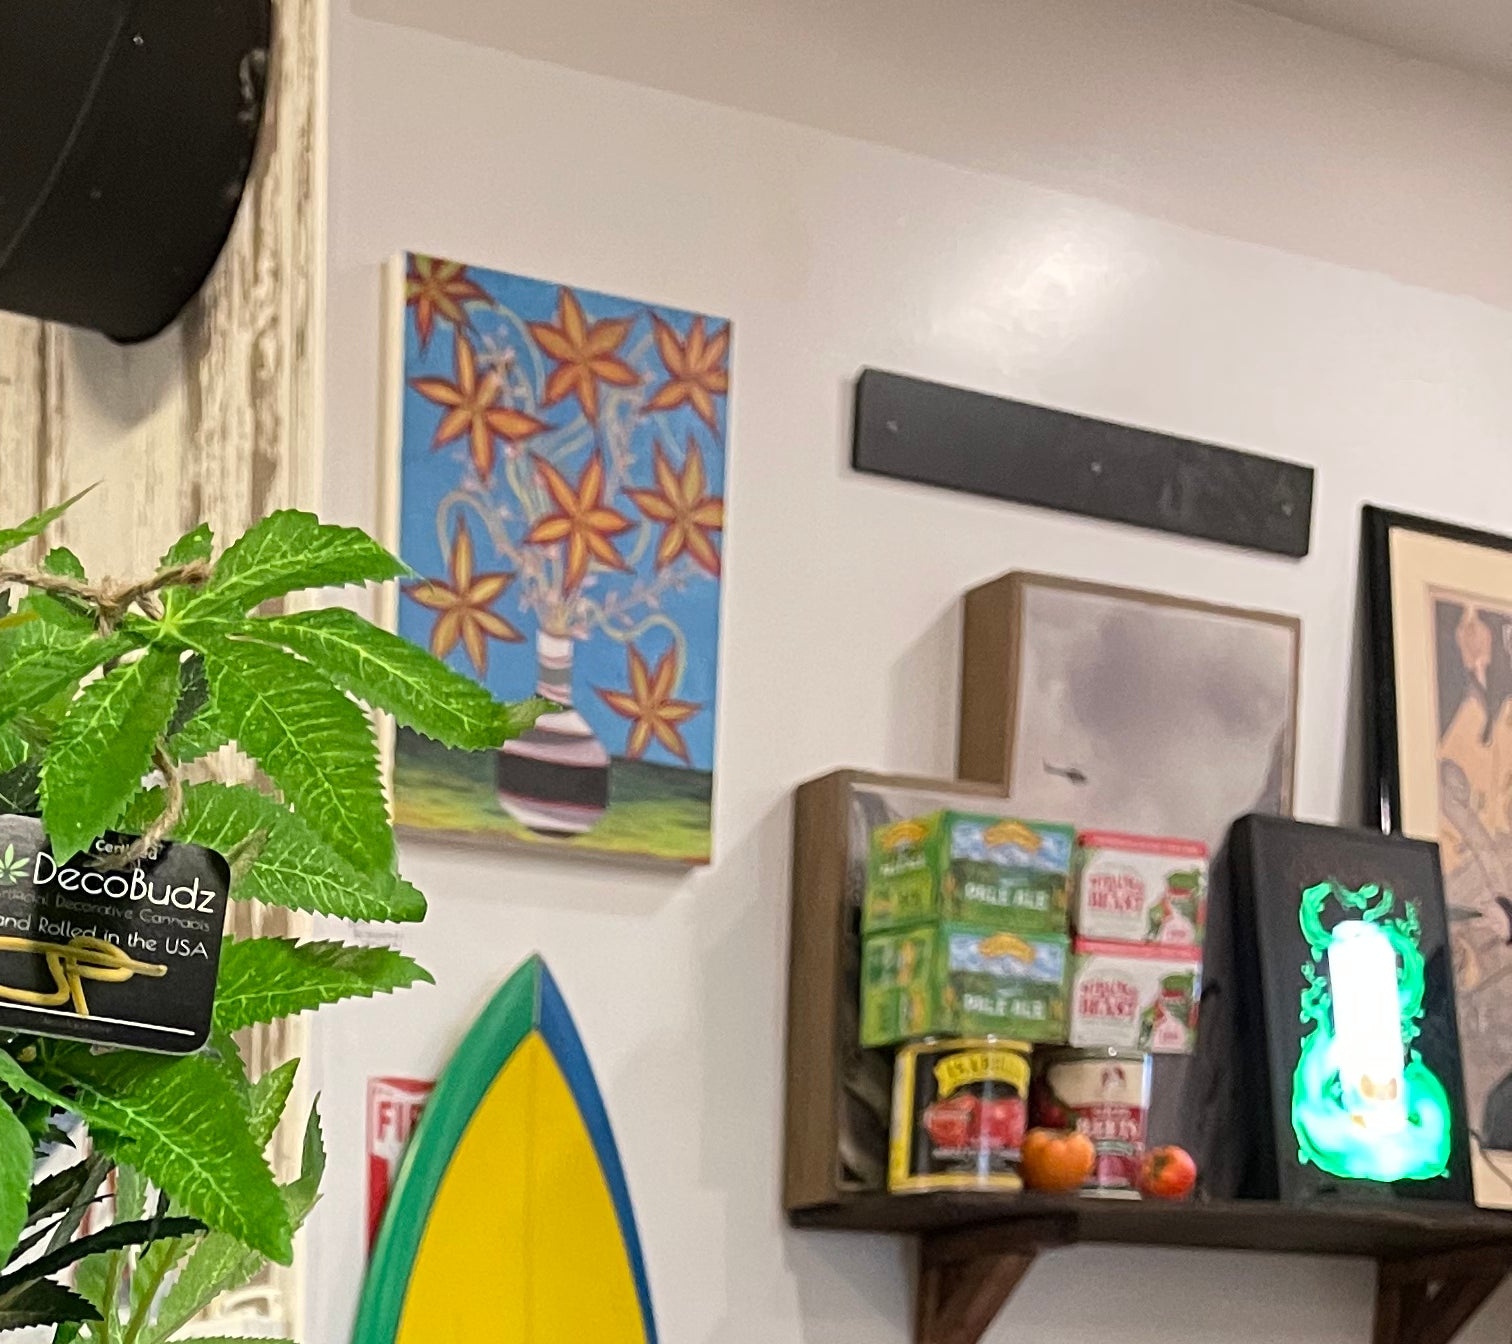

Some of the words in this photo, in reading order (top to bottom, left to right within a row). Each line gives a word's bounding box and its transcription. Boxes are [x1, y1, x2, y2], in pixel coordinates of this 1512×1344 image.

[33, 851, 217, 914] DecoBudz
[54, 894, 134, 920] Decorative
[139, 908, 211, 932] Cannabis
[39, 916, 97, 939] Rolled
[102, 927, 121, 947] in
[127, 931, 158, 952] the
[165, 938, 210, 960] USA
